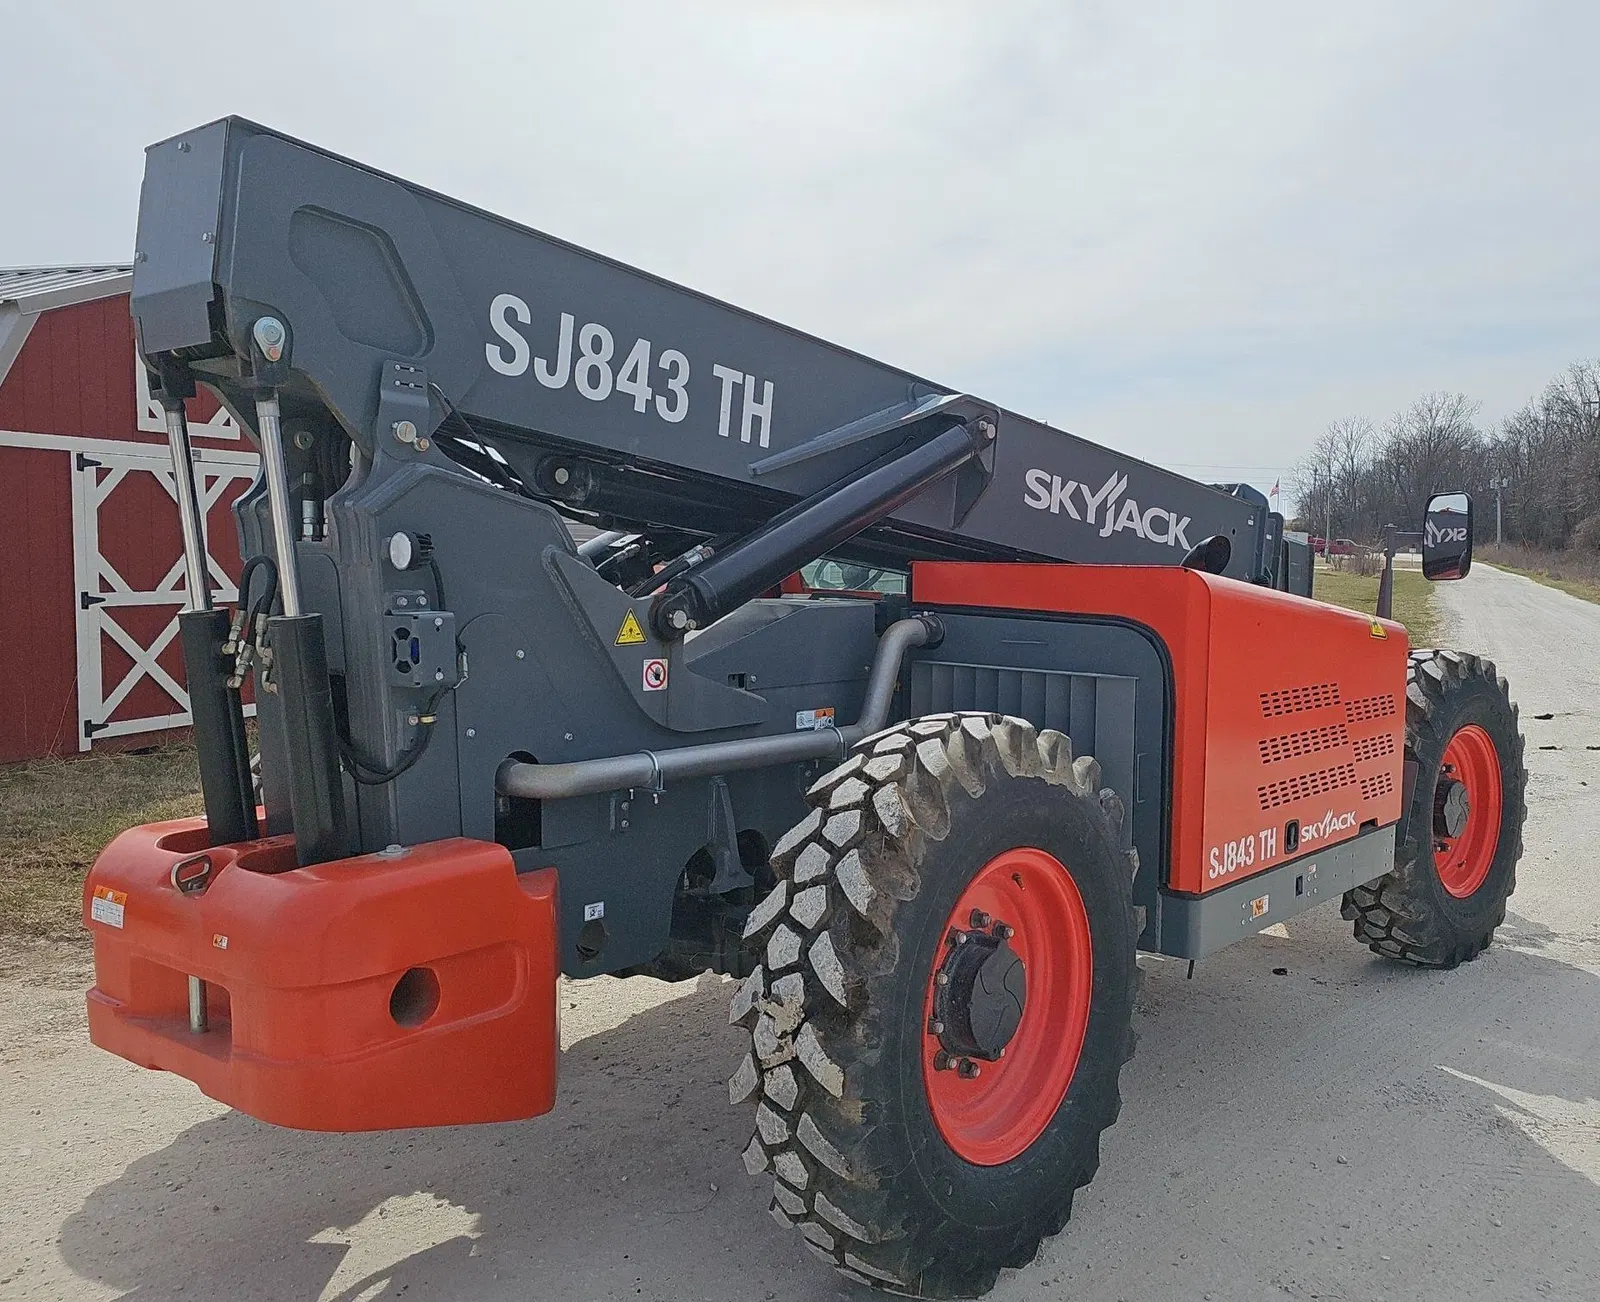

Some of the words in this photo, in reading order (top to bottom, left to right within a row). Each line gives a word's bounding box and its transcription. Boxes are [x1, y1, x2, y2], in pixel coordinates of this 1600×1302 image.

[485, 293, 690, 423] SJ843
[713, 364, 774, 448] TH
[1024, 468, 1192, 551] SKYJACK
[1208, 835, 1255, 879] SJ843
[1259, 827, 1277, 861] TH
[1300, 809, 1358, 843] SKYJACK
